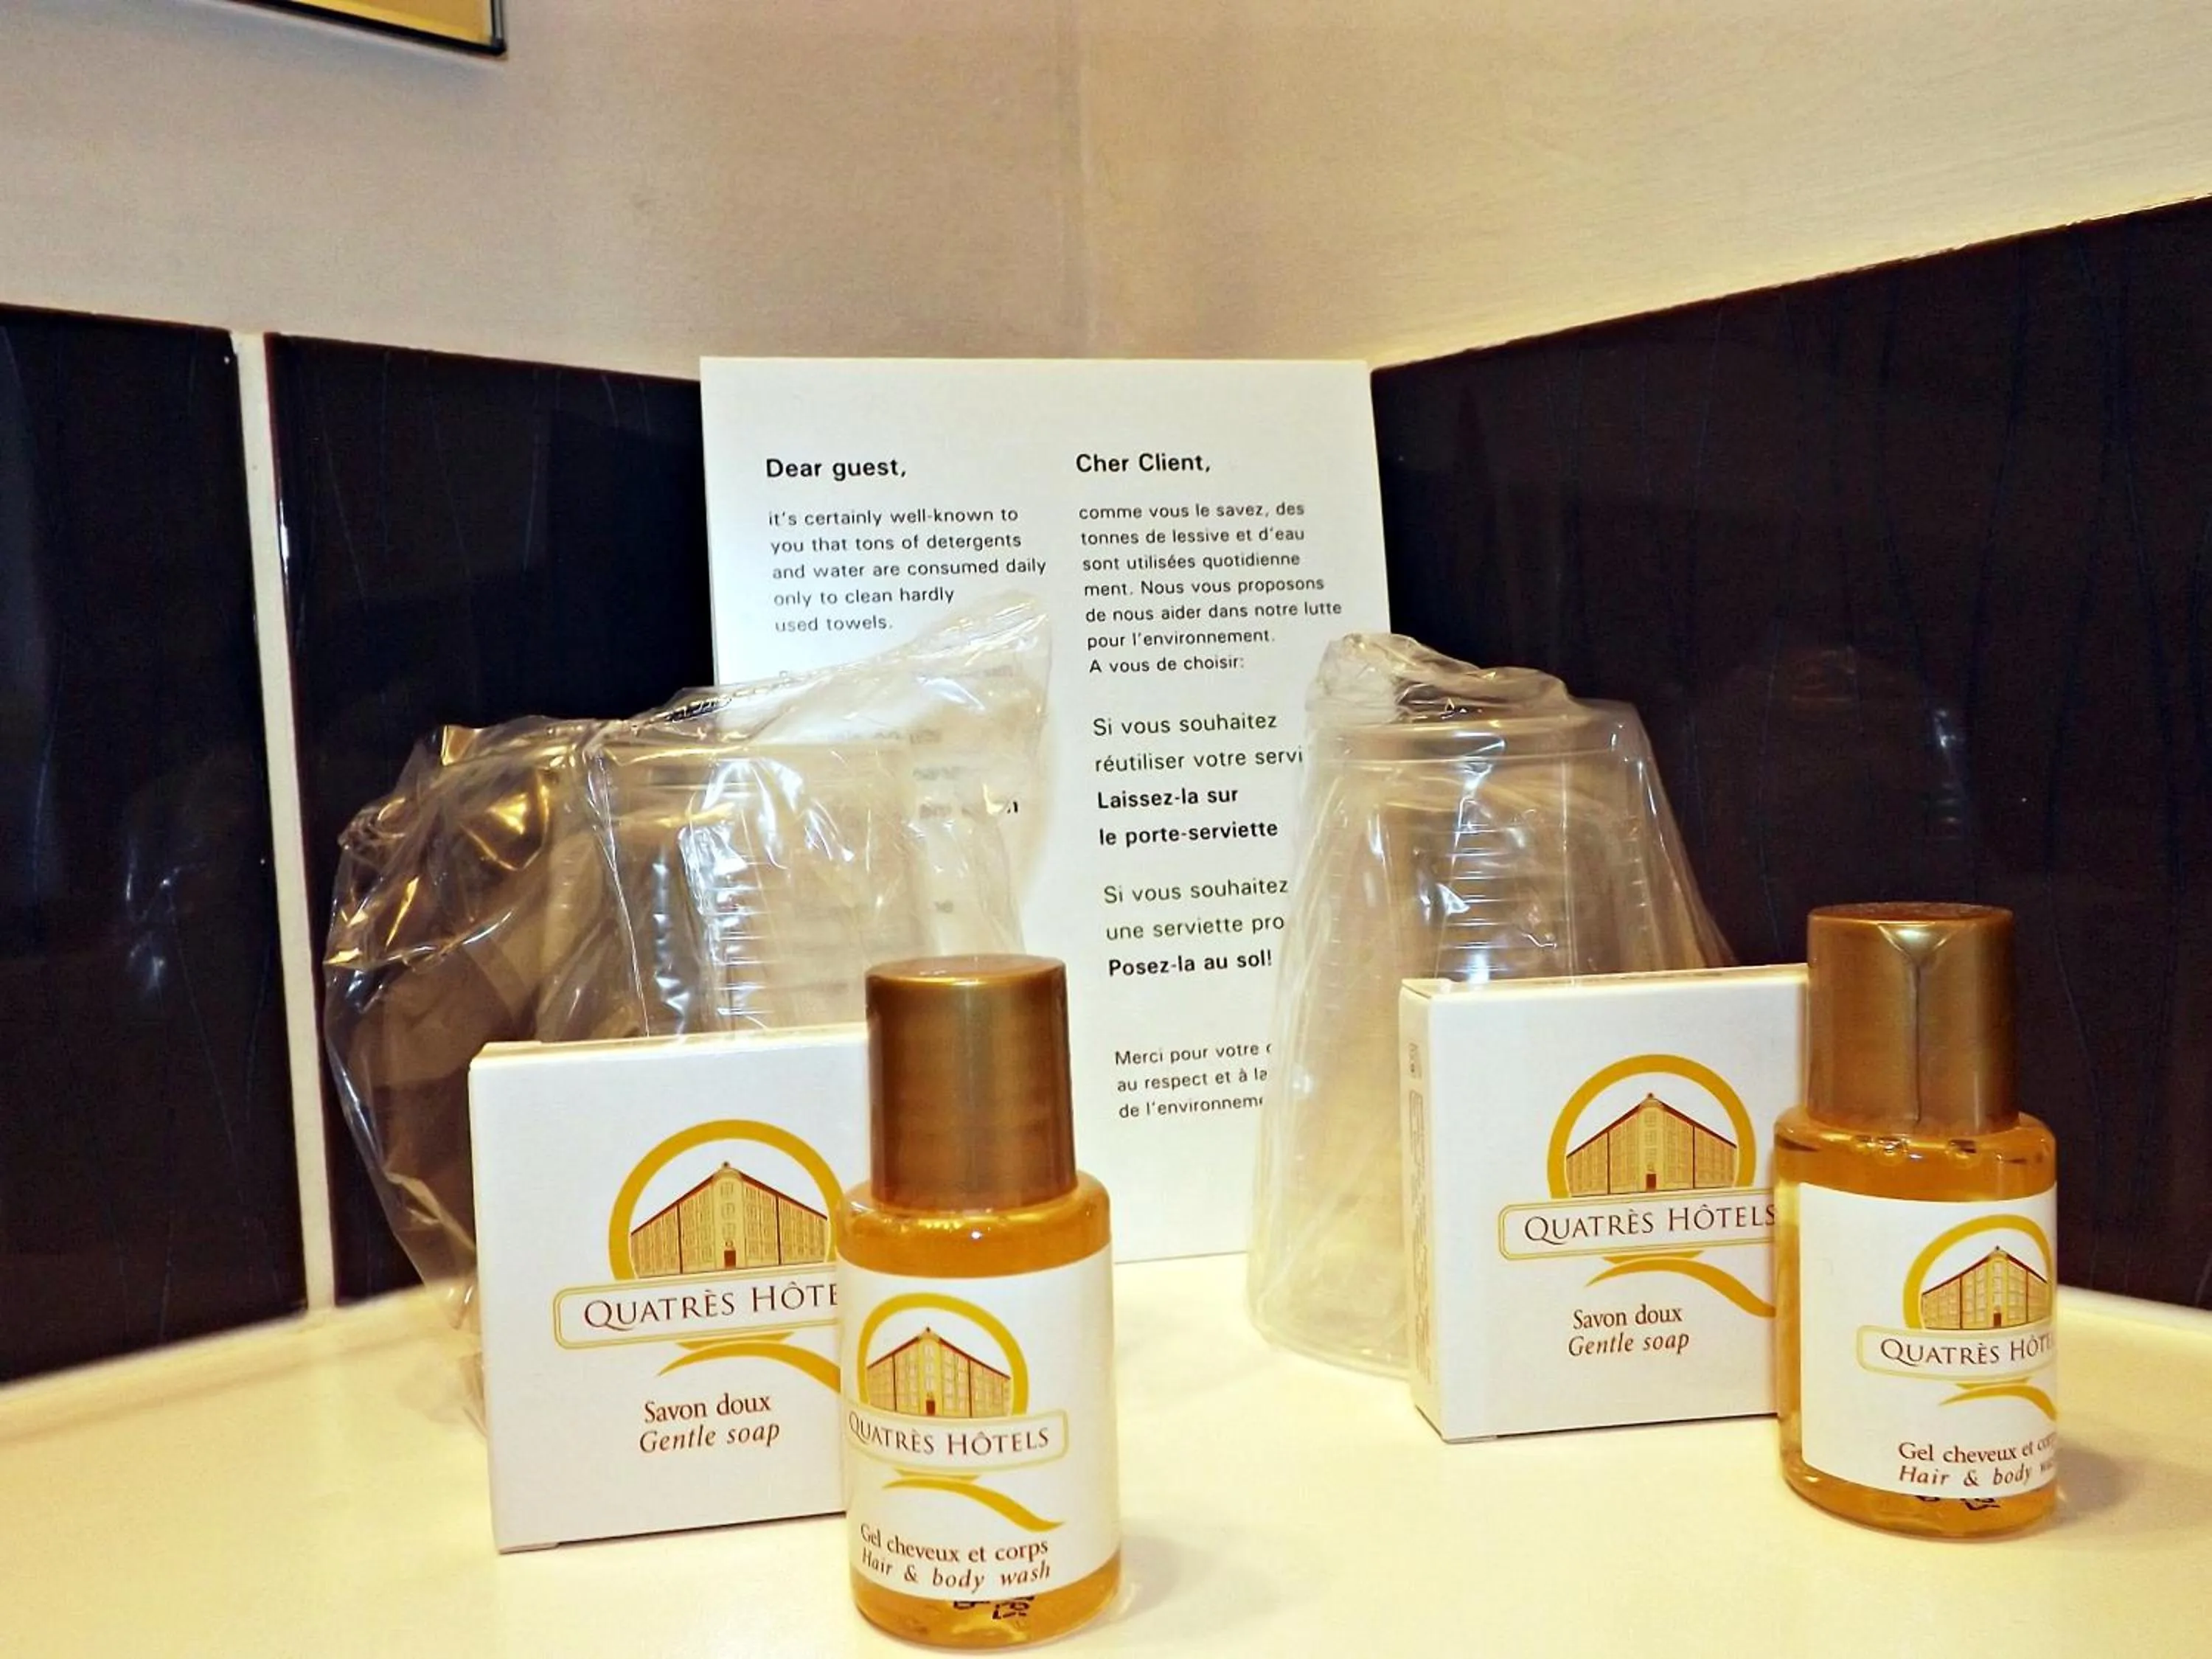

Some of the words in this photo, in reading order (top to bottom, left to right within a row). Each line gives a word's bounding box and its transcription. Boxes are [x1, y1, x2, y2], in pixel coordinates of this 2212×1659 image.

[767, 459, 821, 477] Dear
[832, 460, 905, 481] guest,
[1077, 454, 1129, 472] Cher
[1139, 453, 1209, 472] Client,
[770, 512, 796, 526] it's
[805, 510, 881, 526] certainly
[891, 509, 993, 523] well-known
[1001, 509, 1018, 521] to
[1079, 508, 1141, 519] comme
[1150, 507, 1189, 518] vous
[1196, 504, 1209, 517] le
[1217, 506, 1268, 517] savez,
[1276, 502, 1304, 515] des
[771, 542, 803, 554] you
[813, 538, 846, 551] that
[856, 538, 894, 550] tons
[902, 535, 918, 549] of
[927, 535, 1021, 551] detergents
[1082, 533, 1138, 545] tonnes
[1146, 529, 1165, 543] de
[1173, 529, 1229, 543] lessive
[1237, 530, 1251, 541] et
[1259, 527, 1304, 540] d'eau
[773, 564, 804, 578] and
[814, 566, 864, 577] water
[873, 566, 900, 577] are
[908, 559, 998, 575] consumed
[1006, 558, 1046, 575] daily
[1083, 558, 1119, 571] sont
[1127, 554, 1195, 569] utilisées
[1203, 553, 1299, 570] quotidienne
[774, 591, 811, 607] only
[821, 593, 838, 604] to
[846, 590, 892, 603] clean
[900, 587, 953, 603] hardly
[1085, 584, 1133, 596] ment.
[1141, 581, 1183, 594] Nous
[1192, 582, 1231, 593] vous
[1239, 580, 1324, 594] proposons
[1086, 608, 1106, 622] de
[1113, 610, 1153, 621] nous
[1161, 605, 1200, 619] aider
[1209, 605, 1248, 618] dans
[1255, 605, 1298, 616] notre
[1304, 602, 1341, 615] lutte
[776, 617, 818, 632] used
[827, 615, 892, 630] towels.
[1088, 637, 1125, 650] pour
[1133, 630, 1276, 645] l'environnement.
[1090, 660, 1102, 672] A
[1109, 661, 1150, 672] vous
[1157, 657, 1176, 671] de
[1183, 655, 1245, 670] choisir:
[1093, 718, 1112, 736] Si
[1121, 720, 1170, 734] vous
[1180, 714, 1276, 731] souhaitez
[1096, 754, 1184, 772] réutiliser
[1194, 753, 1245, 767] votre
[1098, 787, 1198, 808] Laissez-la
[1208, 790, 1237, 803] sur
[1100, 829, 1116, 845] le
[1126, 821, 1277, 847] porte-serviette
[1105, 886, 1122, 903] Si
[1133, 887, 1181, 901] vous
[1191, 878, 1287, 898] souhaitez
[1107, 926, 1143, 940] une
[1153, 919, 1242, 936] serviette
[1109, 956, 1194, 976] Posez-la
[1204, 953, 1228, 970] au
[1237, 950, 1271, 967] sol!
[1116, 1051, 1162, 1065] Merci
[1171, 1048, 1207, 1063] pour
[1216, 1045, 1259, 1057] votre
[1117, 1079, 1137, 1092] au
[1145, 1074, 1207, 1091] respect
[1215, 1071, 1230, 1084] et
[1239, 1068, 1248, 1082] à
[1254, 1068, 1267, 1081] la
[1119, 1104, 1138, 1118] de
[1525, 1209, 1653, 1245] QUATRÈS
[1668, 1203, 1775, 1231] HÔTELS
[585, 1290, 734, 1331] QUATRÈS
[1573, 1310, 1627, 1329] Savon
[1635, 1304, 1682, 1324] doux
[1569, 1332, 1633, 1356] Gentle
[1644, 1334, 1688, 1354] soap
[1881, 1339, 1999, 1366] QUATRÈS
[645, 1402, 706, 1422] Savon
[717, 1393, 770, 1416] doux
[640, 1425, 715, 1452] Gentle
[727, 1424, 779, 1447] soap
[849, 1411, 935, 1455] QUATRÈS
[947, 1427, 1048, 1455] HÔTELS
[1899, 1442, 1933, 1461] Gel
[1943, 1445, 2017, 1463] cheveux
[2022, 1441, 2033, 1456] et
[1899, 1465, 1950, 1485] Hair
[1964, 1472, 1978, 1486] &
[1993, 1463, 2031, 1485] body
[861, 1524, 881, 1548] Gel
[887, 1535, 959, 1562] cheveux
[968, 1547, 984, 1562] et
[995, 1543, 1048, 1562] corps
[861, 1547, 894, 1576] Hair
[904, 1565, 917, 1582] &
[933, 1568, 984, 1593] body
[1001, 1560, 1050, 1585] wash
